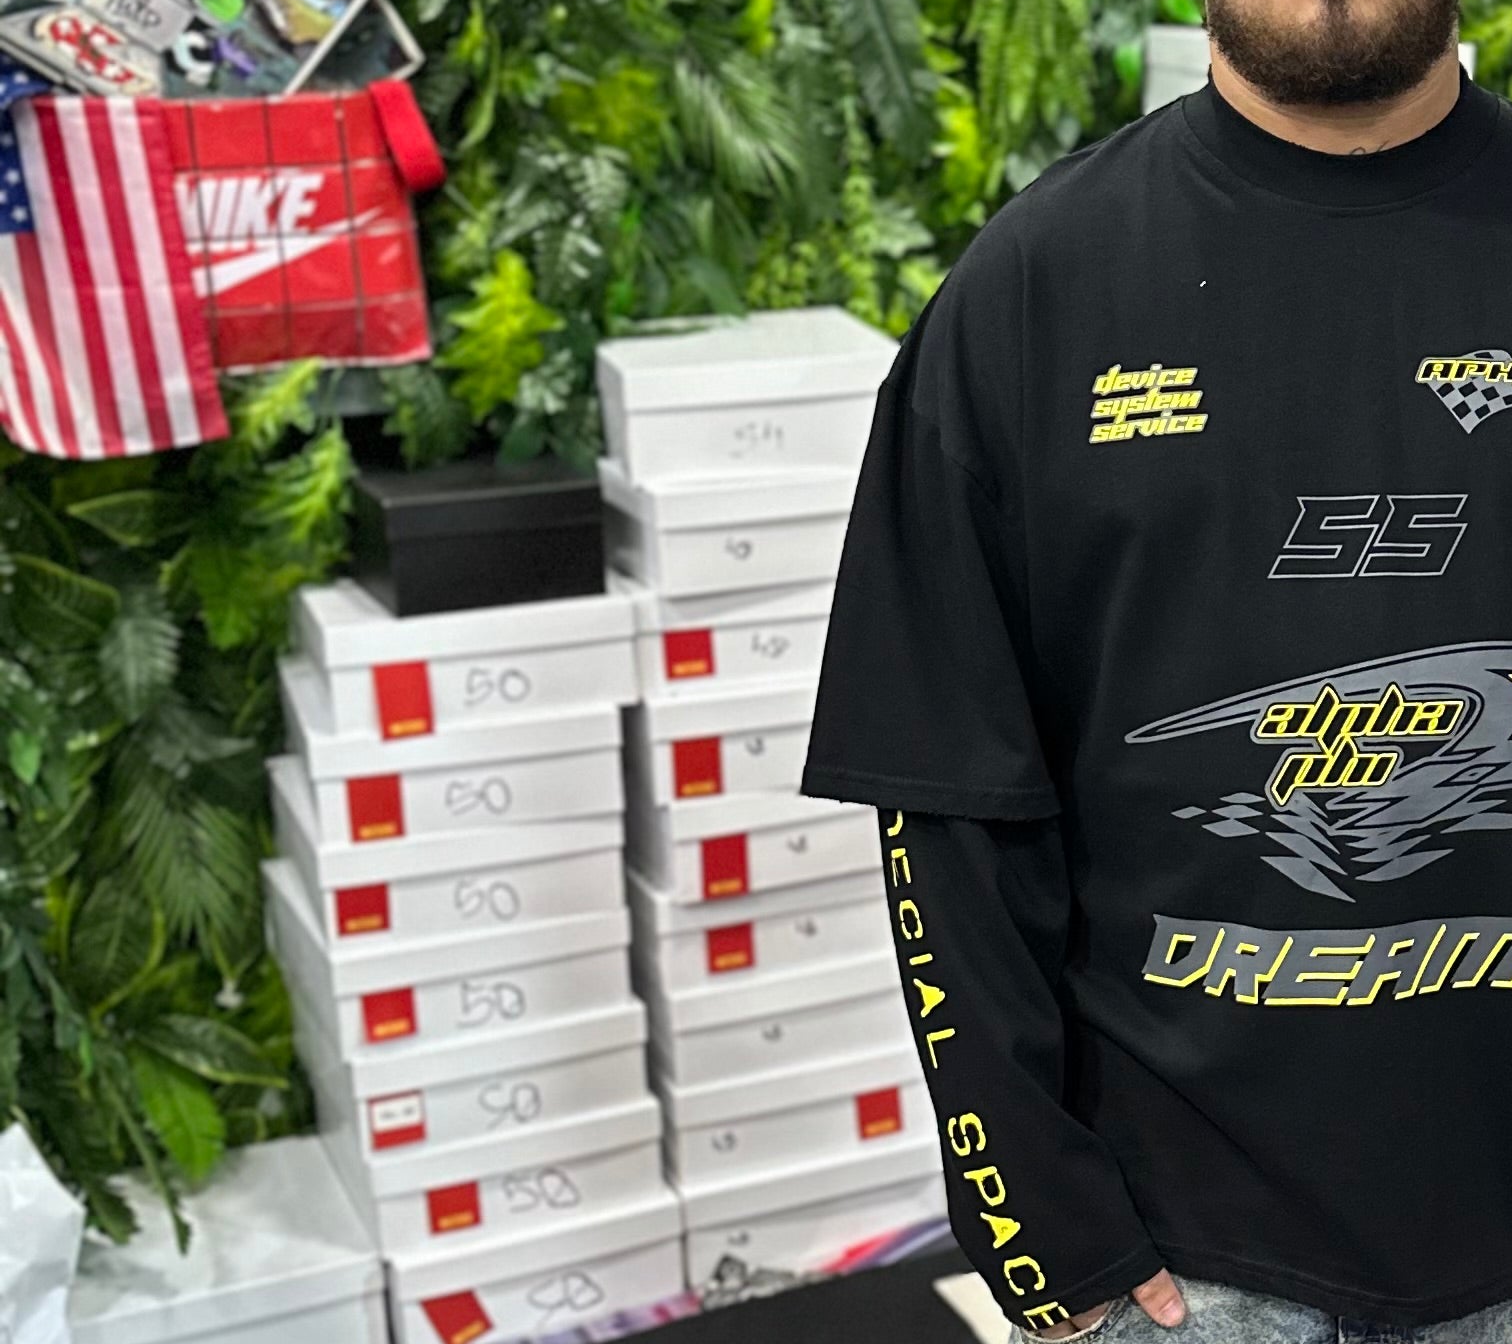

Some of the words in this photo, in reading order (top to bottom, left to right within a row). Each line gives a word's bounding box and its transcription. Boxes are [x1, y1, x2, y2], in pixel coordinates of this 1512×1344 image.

[1091, 363, 1198, 396] device
[1089, 409, 1209, 444] service
[1090, 387, 1204, 424] system
[463, 667, 533, 709] 50
[1256, 683, 1466, 753] alpha
[443, 775, 513, 817] 50
[453, 877, 522, 922] 50
[456, 980, 528, 1029] 50
[502, 1168, 582, 1213] 50
